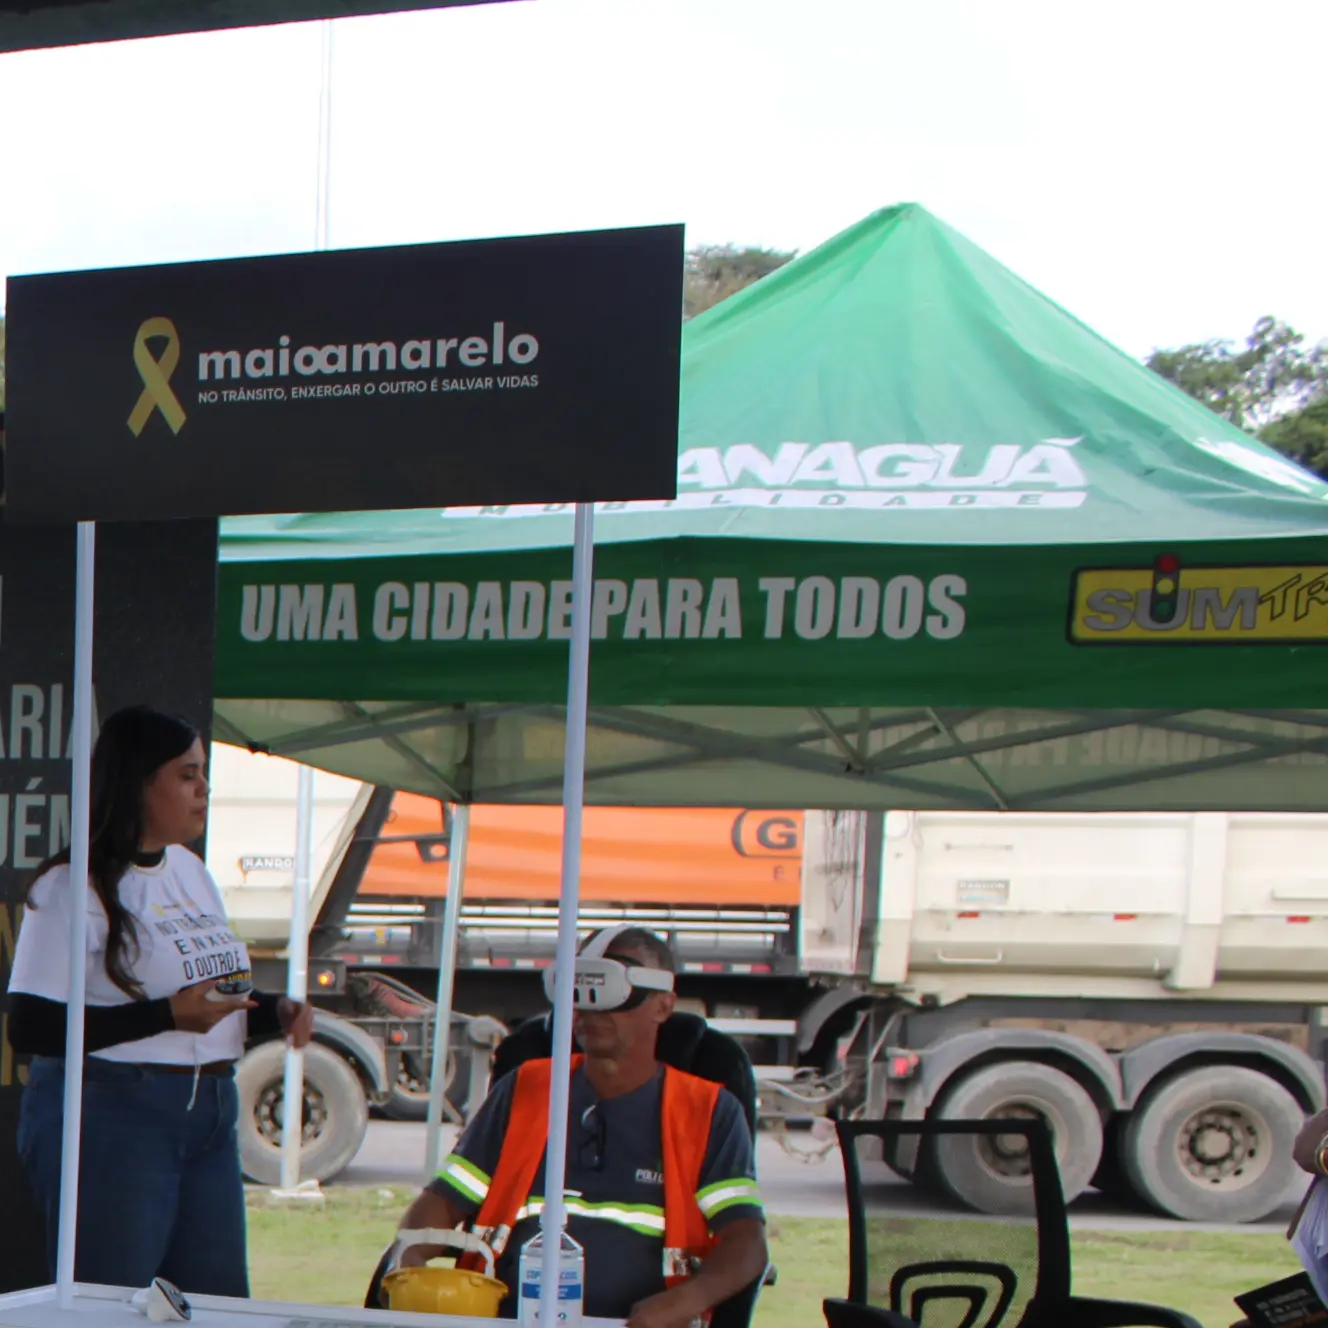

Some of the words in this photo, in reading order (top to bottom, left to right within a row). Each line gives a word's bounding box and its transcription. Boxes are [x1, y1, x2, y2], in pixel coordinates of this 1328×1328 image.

[198, 390, 218, 404] NO
[221, 387, 288, 403] TRÂNSITO,
[291, 384, 361, 399] ENXERGAR
[364, 383, 376, 395] O
[379, 380, 427, 394] OUTRO
[430, 377, 439, 392] É
[442, 377, 493, 392] SALVAR
[497, 374, 539, 389] VIDAS
[678, 434, 1088, 489] ANAGUÁ
[240, 582, 358, 642] UMA
[372, 580, 574, 642] CIDADE
[590, 577, 742, 640] PARA
[758, 573, 968, 641] TODOS
[195, 951, 234, 977] OUTRO
